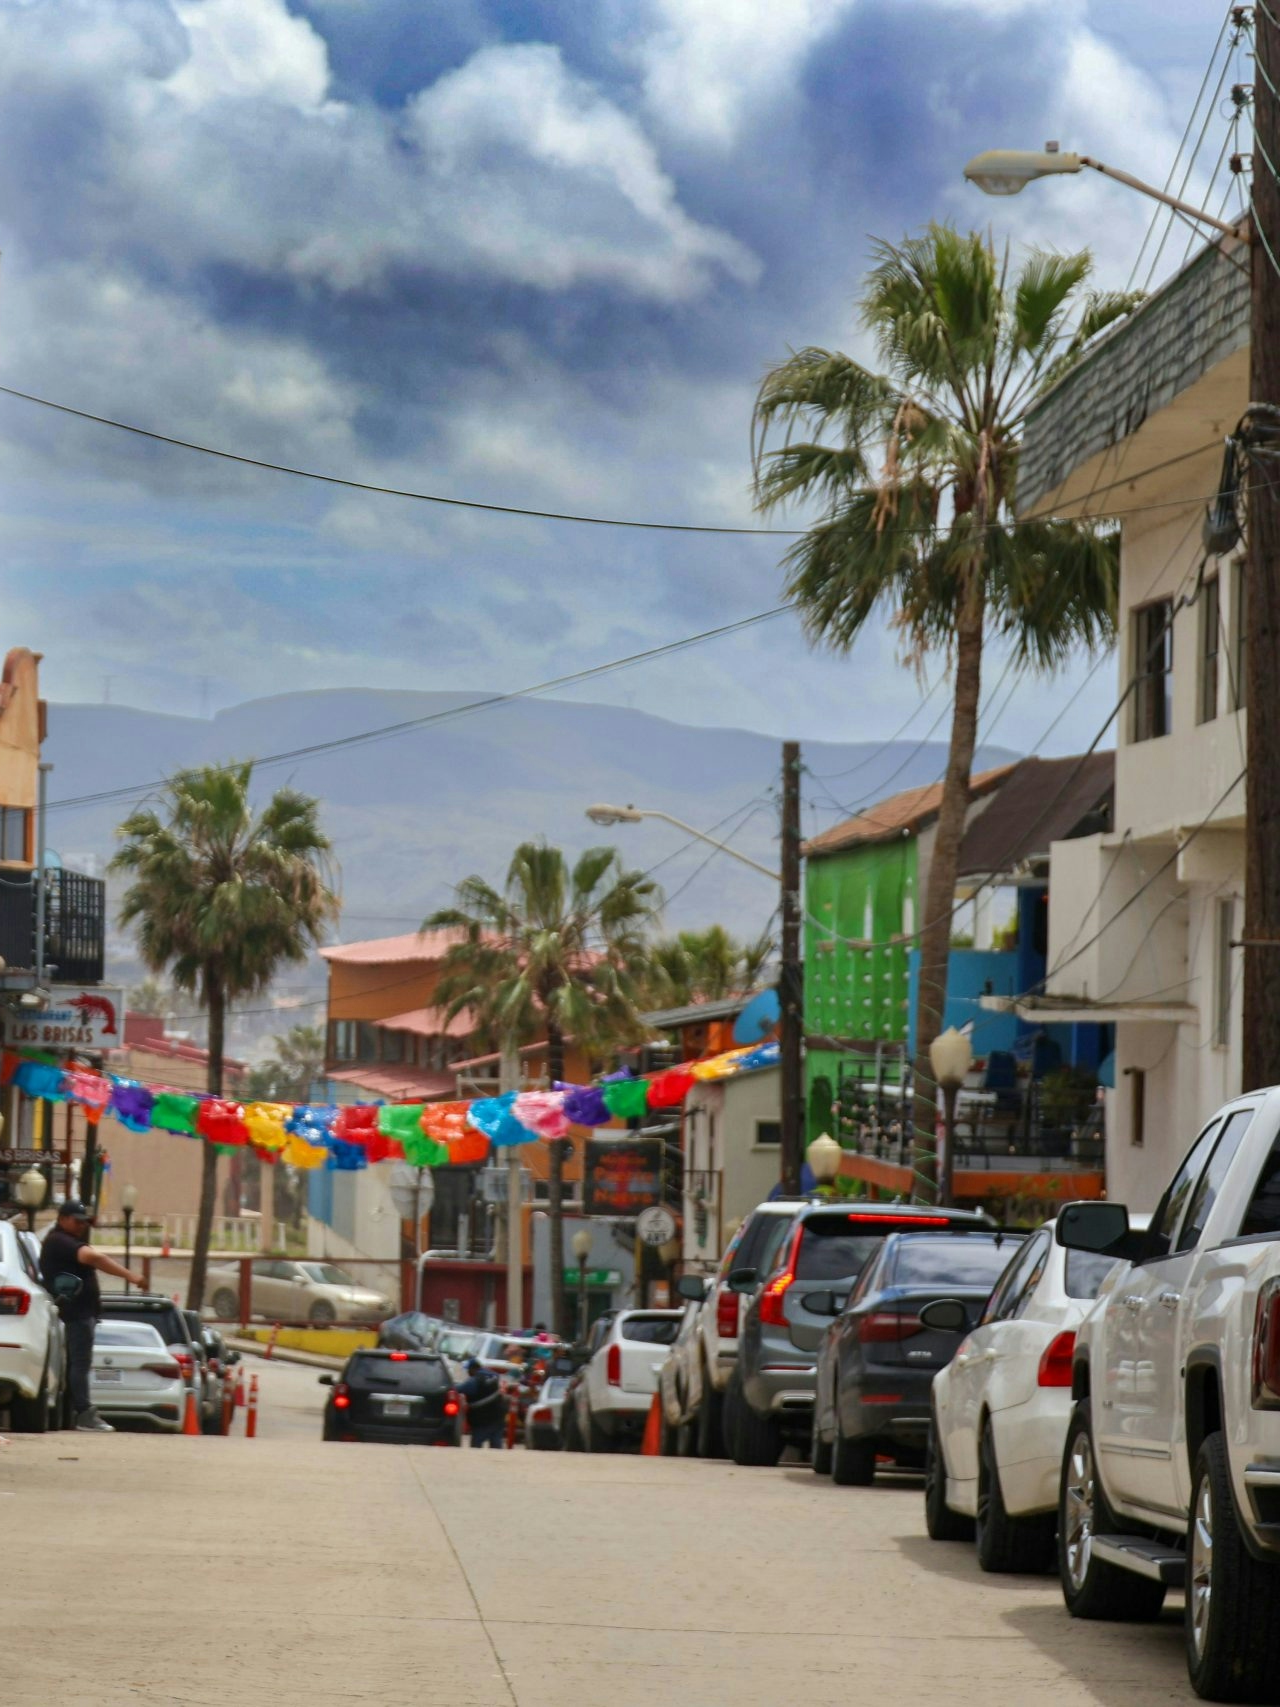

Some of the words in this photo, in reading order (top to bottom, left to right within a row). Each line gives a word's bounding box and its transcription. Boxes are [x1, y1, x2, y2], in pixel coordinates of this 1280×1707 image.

[11, 1024, 39, 1041] LAS
[42, 1025, 94, 1043] BRISAS
[14, 1148, 61, 1162] BRISAS
